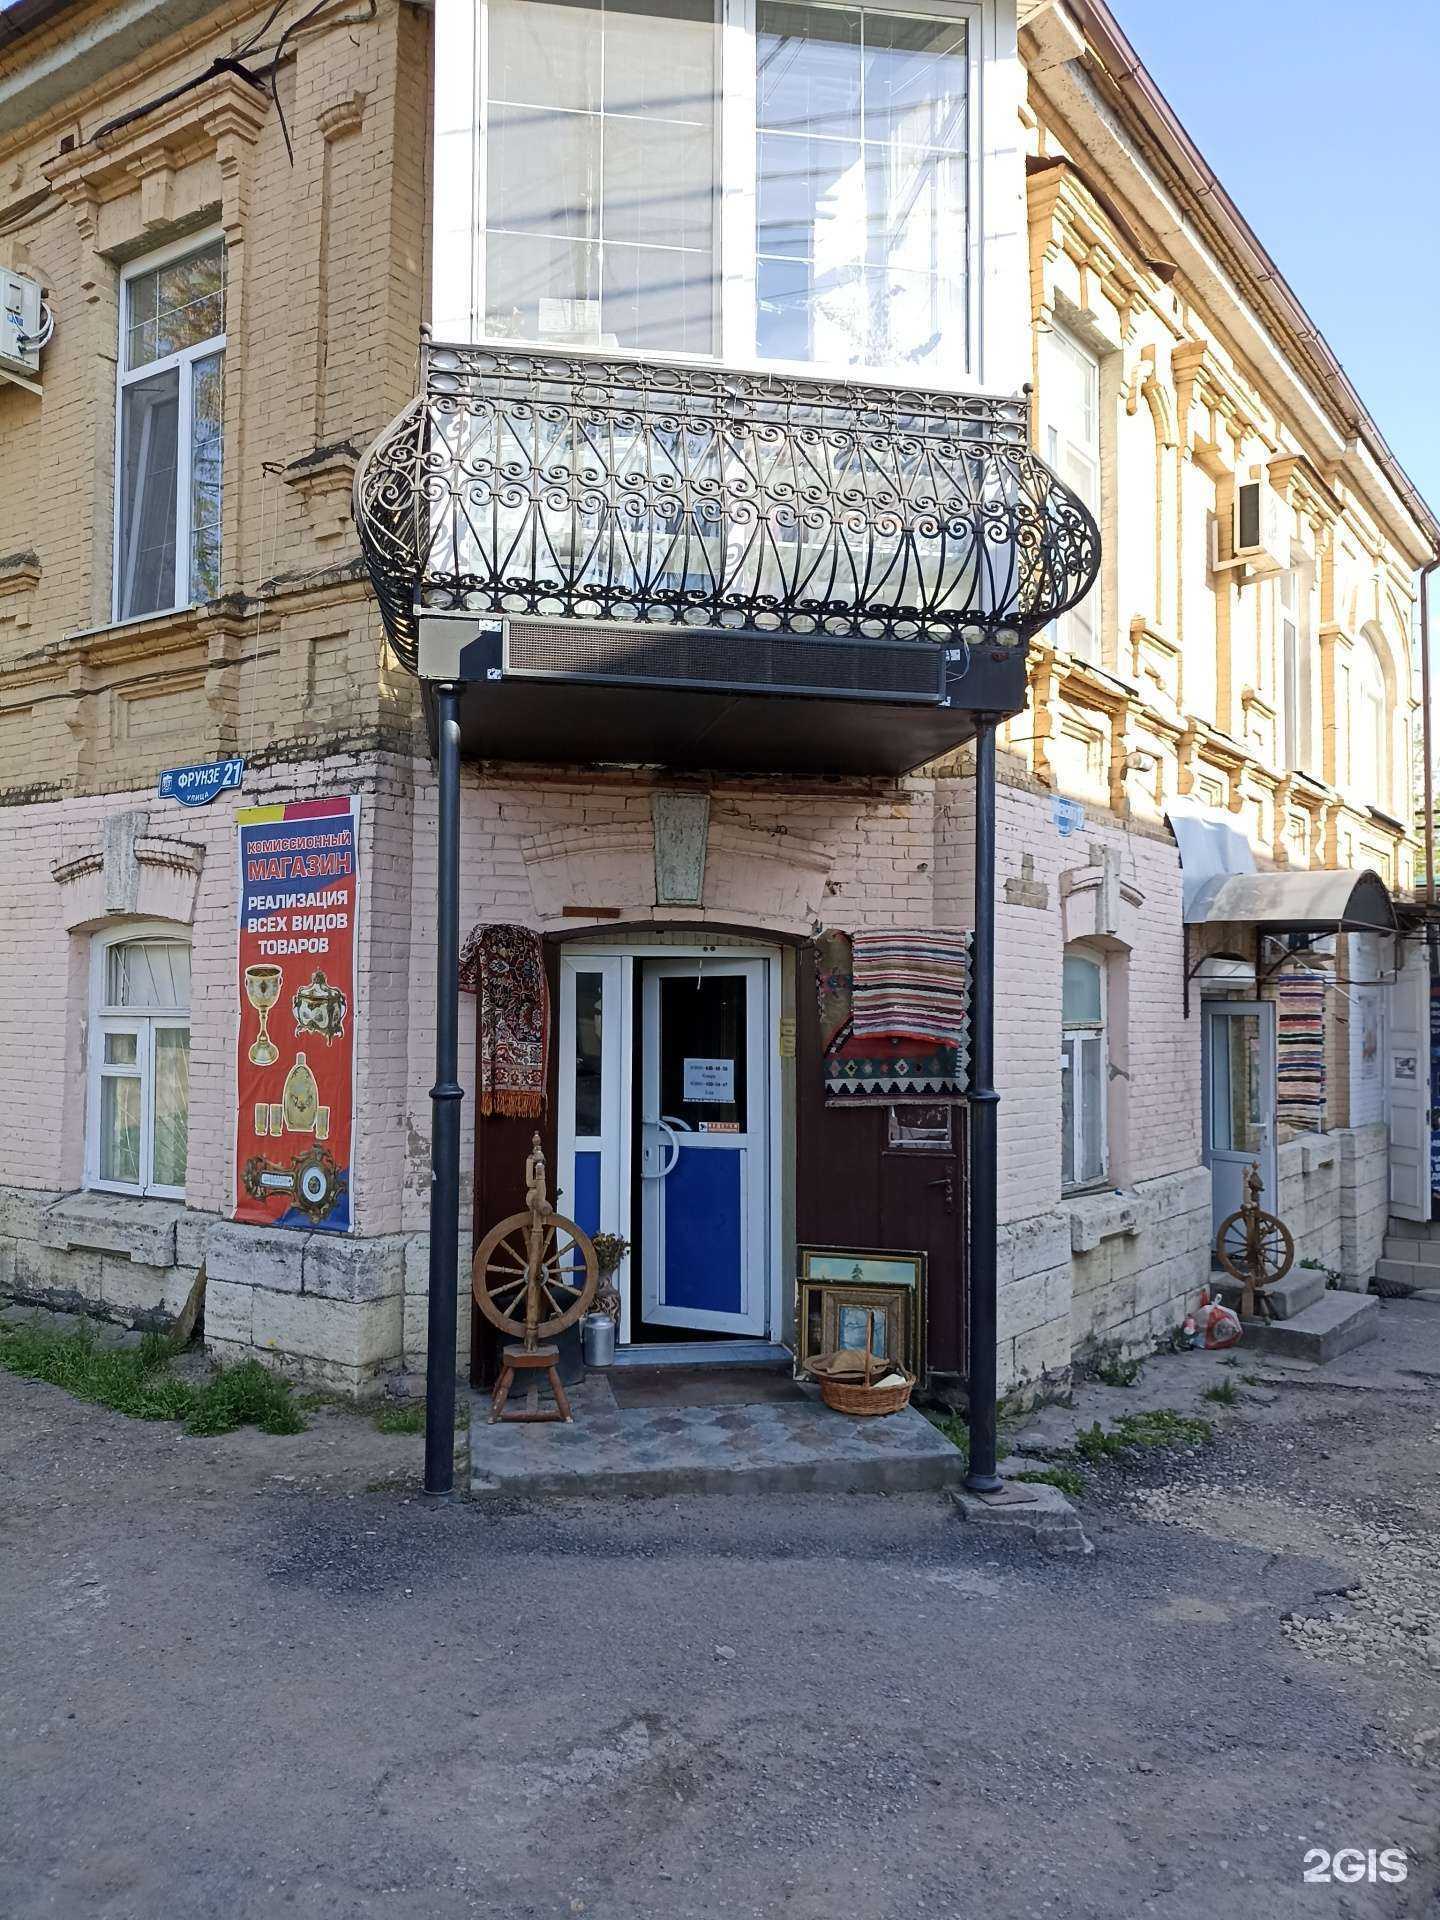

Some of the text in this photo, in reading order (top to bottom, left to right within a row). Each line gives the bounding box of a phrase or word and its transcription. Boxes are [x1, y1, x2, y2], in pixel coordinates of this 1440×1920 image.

[178, 762, 241, 788] ФРУНЗЕ 21
[186, 791, 209, 801] УЛИЦА
[247, 830, 352, 854] КОМИССИОННЫЙ
[247, 852, 352, 881] МАГАЗИН
[248, 890, 348, 910] РЕАЛИЗАЦИЯ
[247, 913, 348, 933] ВСЕХ ВИДОВ
[258, 937, 329, 955] ТОВАРОВ
